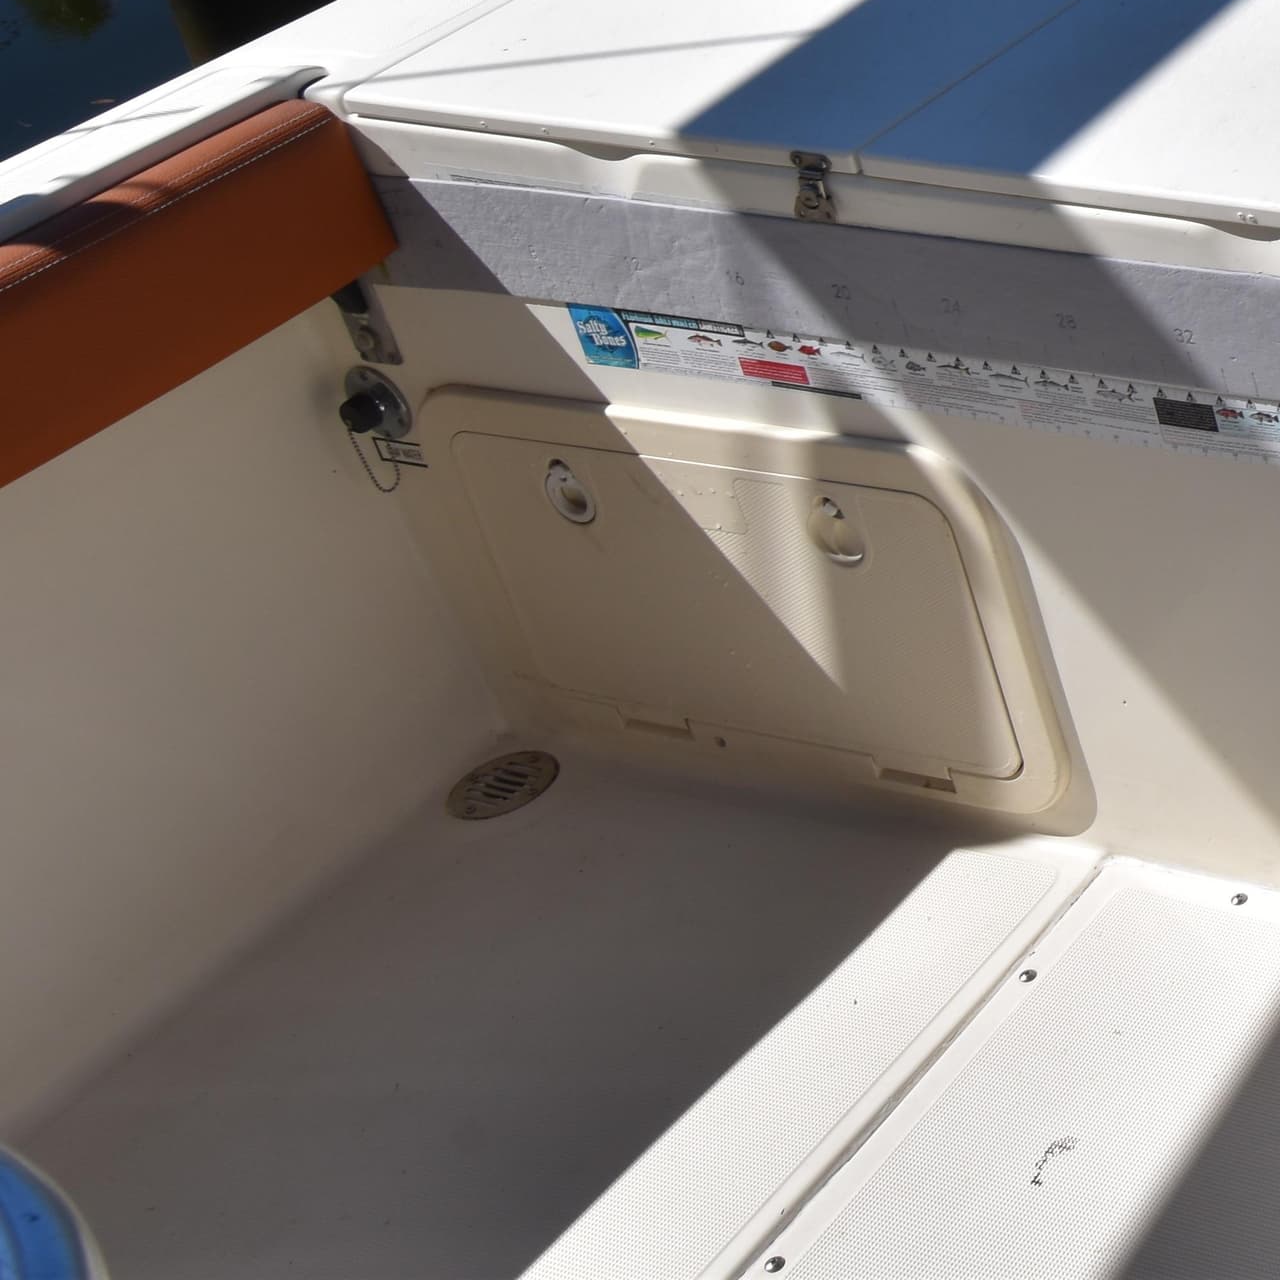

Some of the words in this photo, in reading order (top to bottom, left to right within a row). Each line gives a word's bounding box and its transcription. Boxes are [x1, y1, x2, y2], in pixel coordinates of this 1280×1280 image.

[831, 283, 851, 300] 20
[1173, 327, 1197, 345] 32
[576, 318, 608, 336] Salty
[590, 333, 627, 347] Bones
